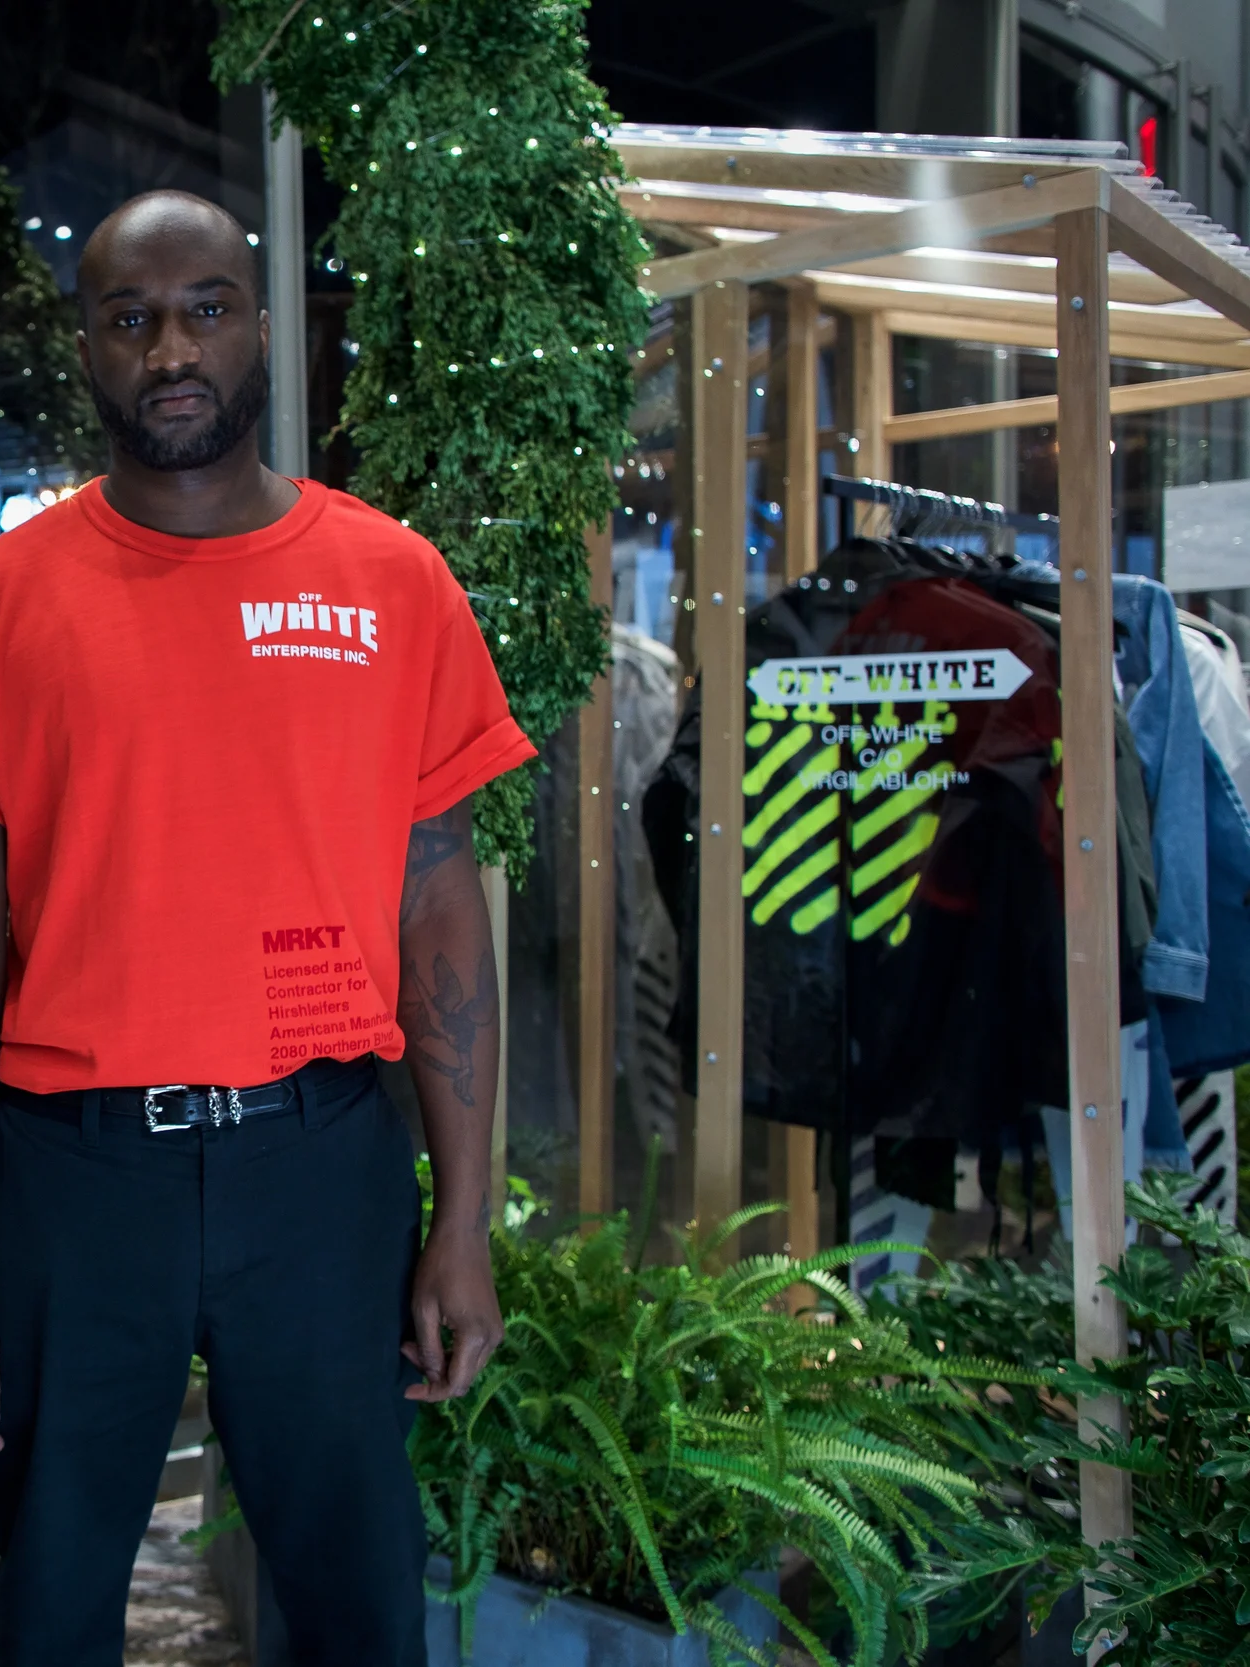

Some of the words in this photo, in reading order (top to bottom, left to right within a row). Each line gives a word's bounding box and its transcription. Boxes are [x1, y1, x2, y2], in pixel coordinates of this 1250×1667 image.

[298, 592, 323, 602] OFF
[240, 602, 378, 653] WHITE
[251, 645, 341, 661] ENTERPRISE
[344, 650, 370, 666] INC.
[777, 659, 995, 694] OFF-WHITE
[821, 724, 943, 744] OFF-WHITE
[859, 748, 903, 767] C/O
[799, 771, 866, 791] VIRGIL
[262, 925, 346, 954] MRKT
[263, 961, 329, 980] Licensed
[333, 957, 363, 973] and
[266, 981, 342, 1000] Contractor
[347, 977, 369, 992] for
[268, 1001, 350, 1020] Hirshleifers
[270, 1020, 347, 1041] Americana
[270, 1044, 307, 1060] 2080
[312, 1035, 371, 1056] Northern
[373, 1028, 394, 1047] Blvd
